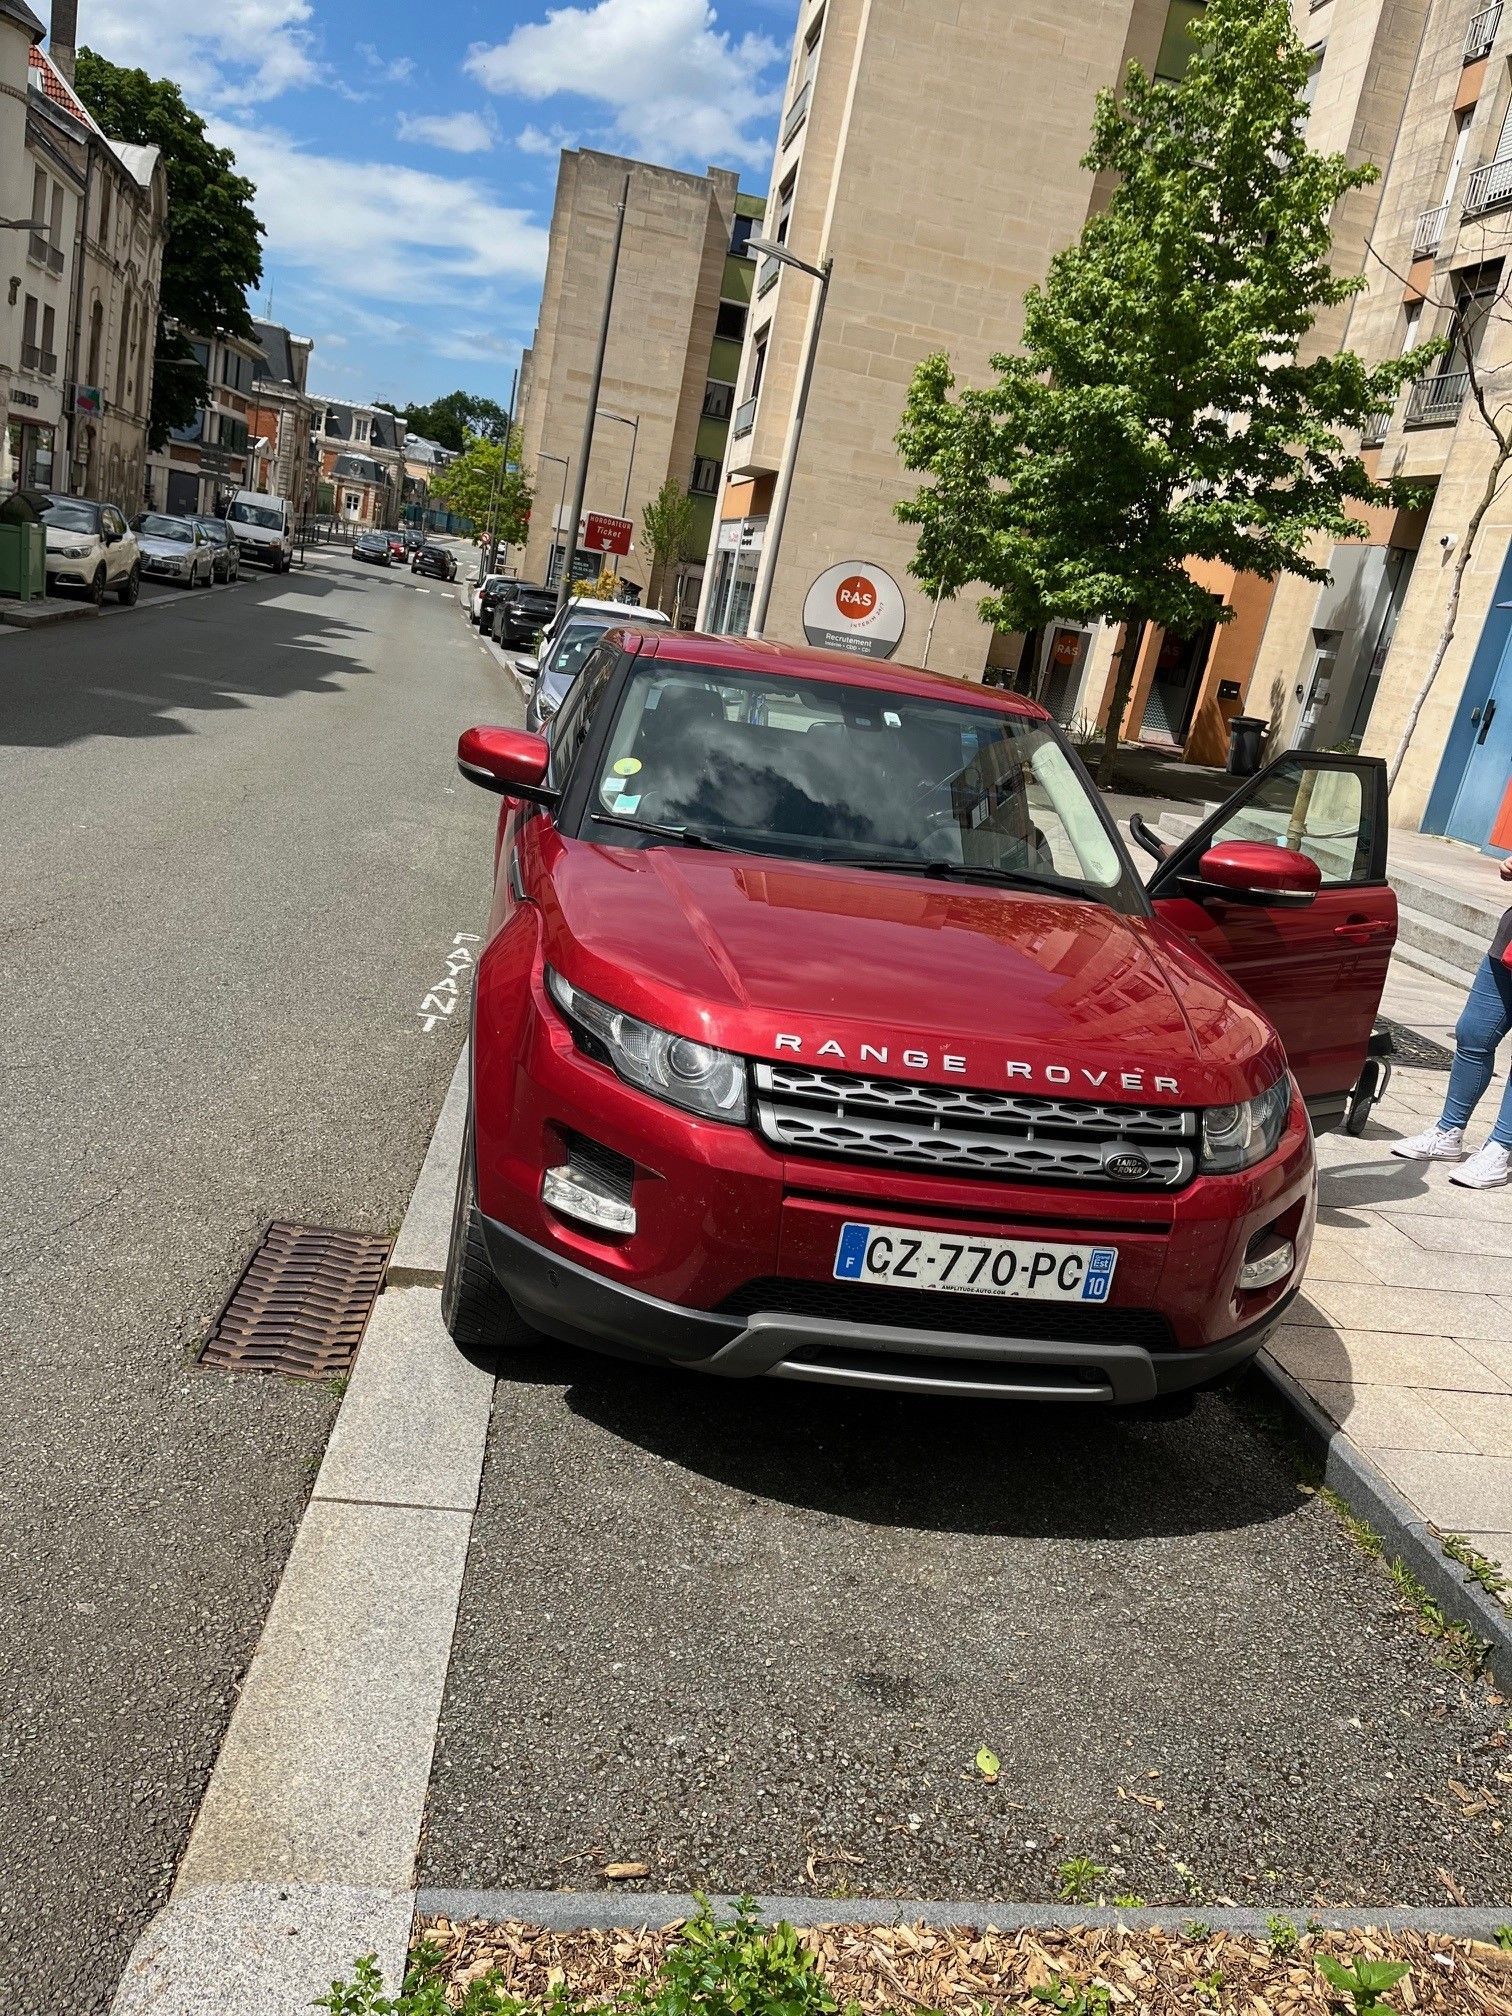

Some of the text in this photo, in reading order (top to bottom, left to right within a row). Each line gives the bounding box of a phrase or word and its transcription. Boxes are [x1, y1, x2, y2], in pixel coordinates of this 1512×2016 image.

[590, 516, 631, 530] HORODATEUR
[597, 526, 621, 538] Ticket
[826, 633, 872, 647] Recrutement
[417, 931, 481, 1032] PAYANT
[775, 1033, 1180, 1094] RANGE ROVER
[845, 1257, 855, 1269] F
[865, 1236, 1083, 1291] CZ-770-PC
[1093, 1258, 1109, 1268] Est
[1088, 1277, 1105, 1296] 10
